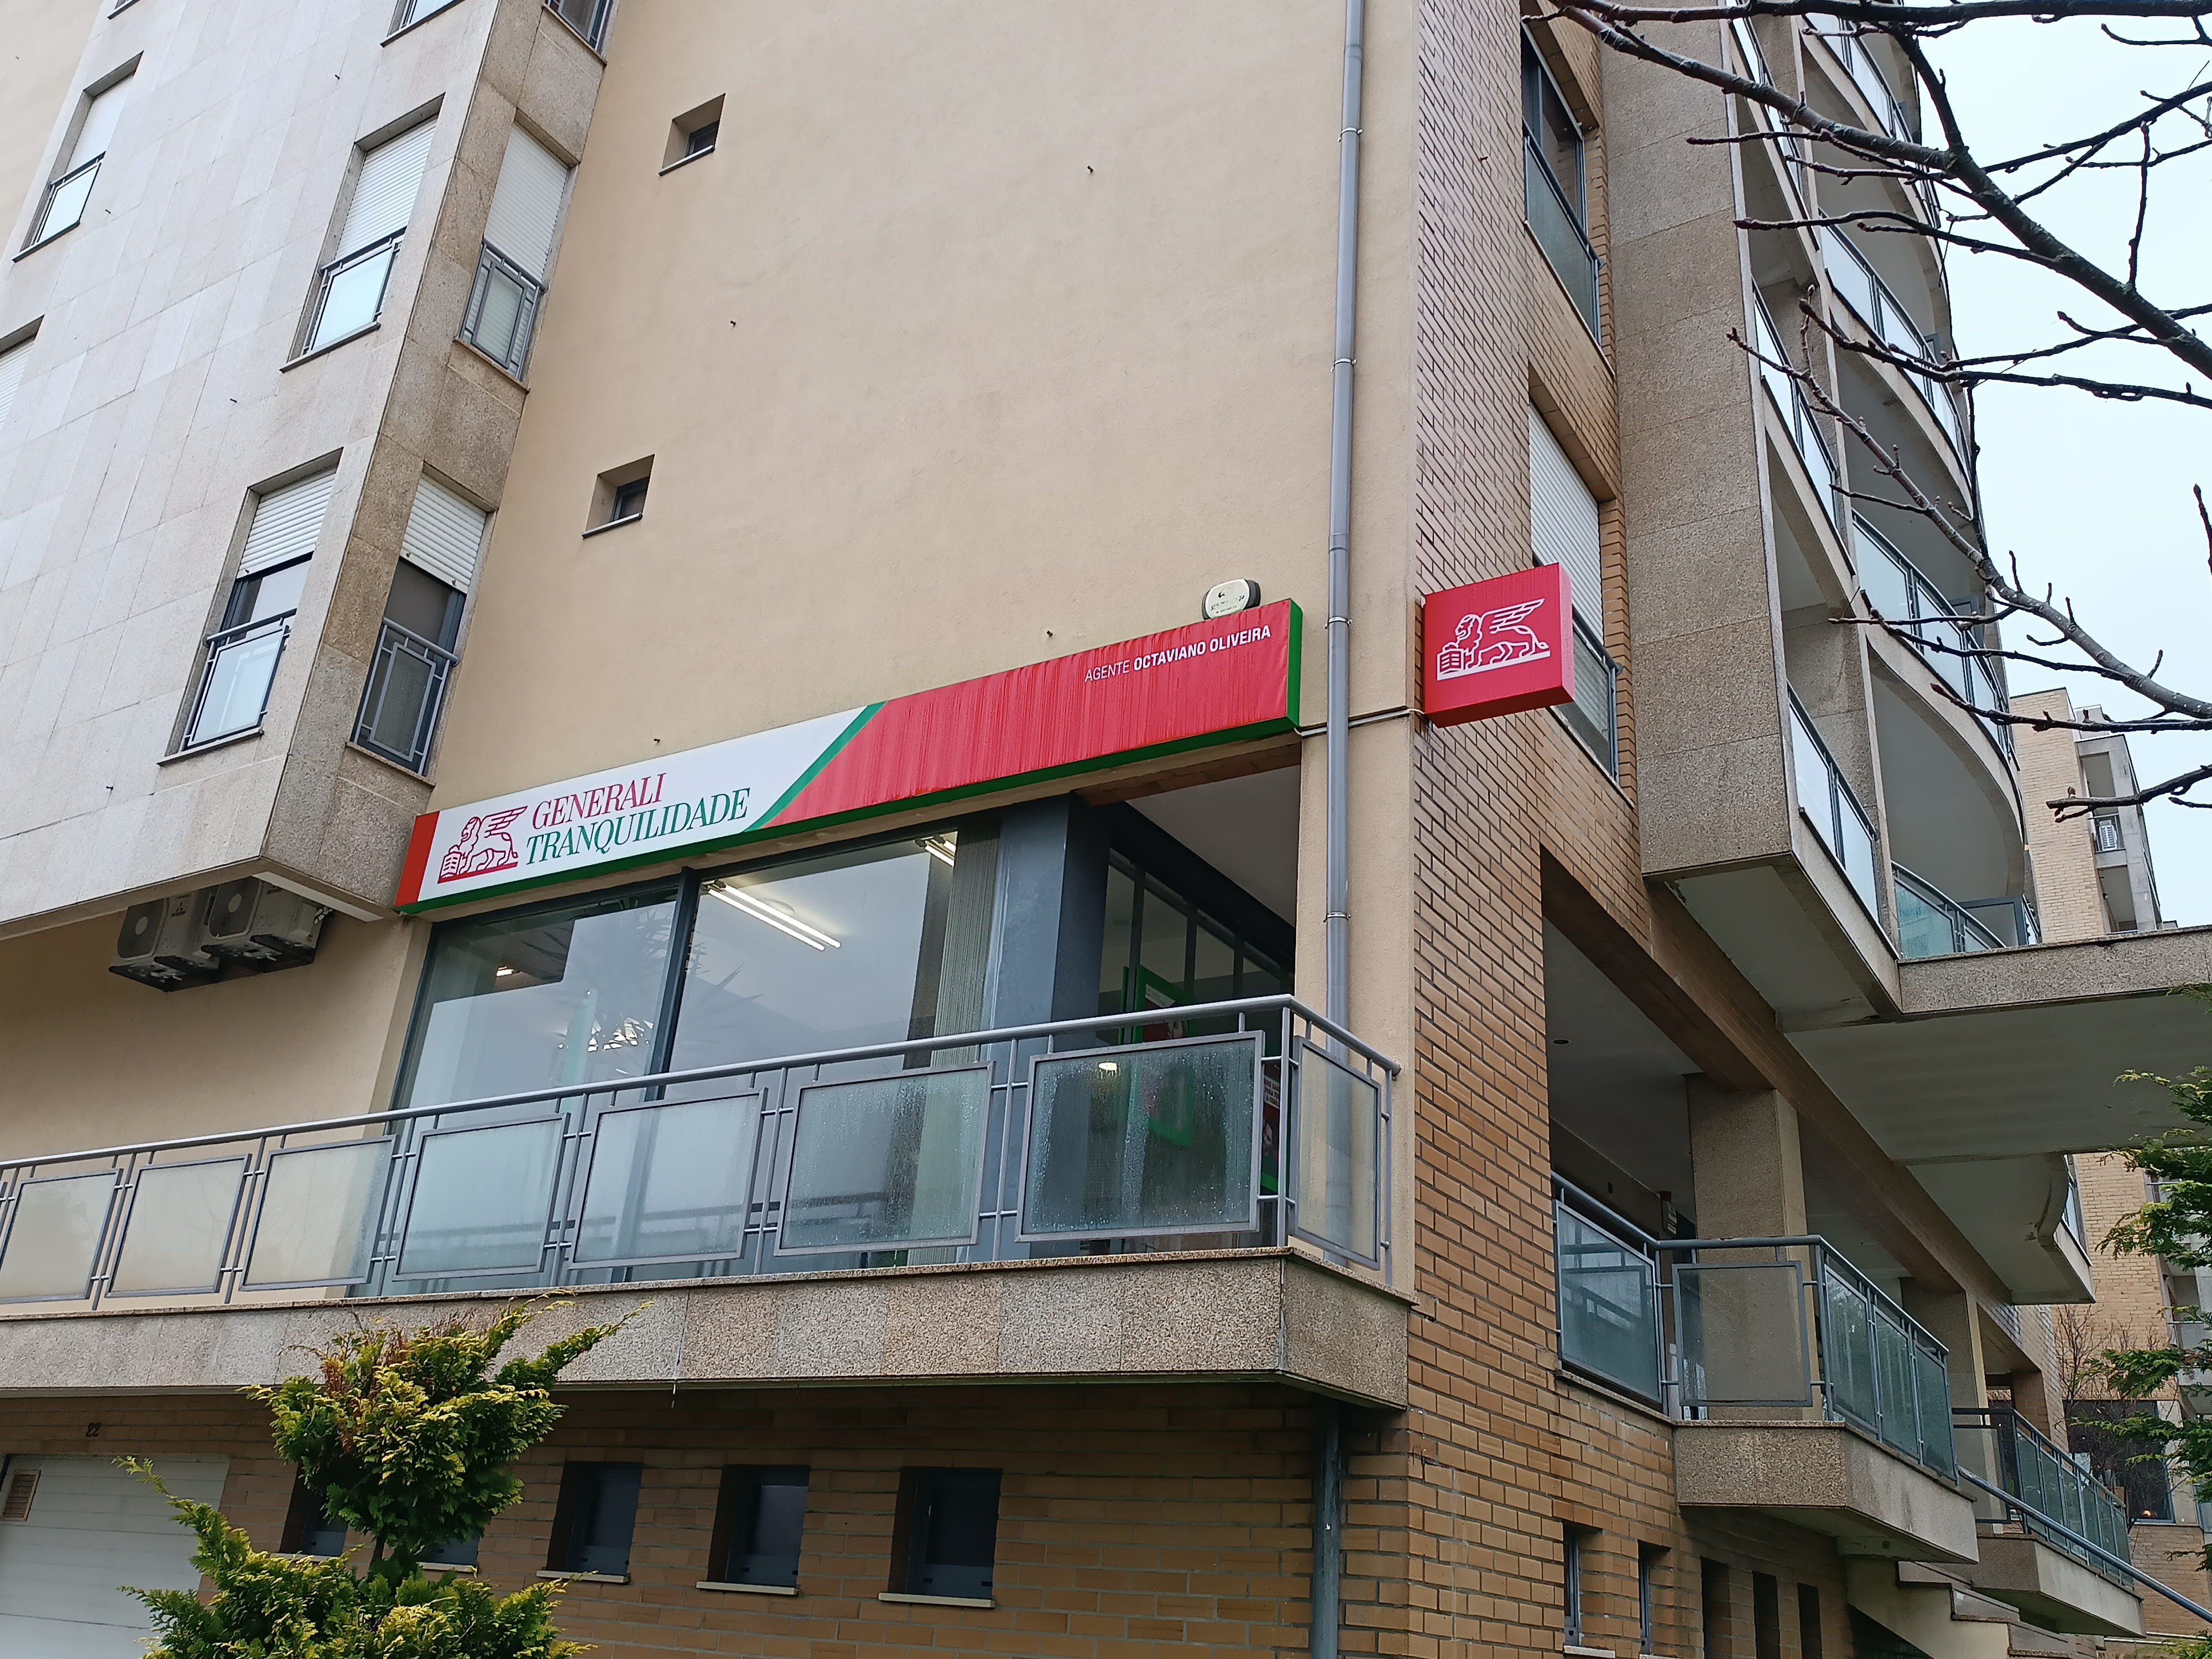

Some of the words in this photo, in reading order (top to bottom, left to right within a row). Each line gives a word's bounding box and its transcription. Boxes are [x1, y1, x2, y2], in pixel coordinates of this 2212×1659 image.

[1084, 660, 1130, 683] AGENTE
[1134, 641, 1206, 671] OCTAVIANO
[1209, 625, 1271, 652] OLIVEIRA
[526, 787, 750, 865] TRANQUILIDADE
[532, 773, 666, 830] GENERALI
[85, 1422, 101, 1437] 22
